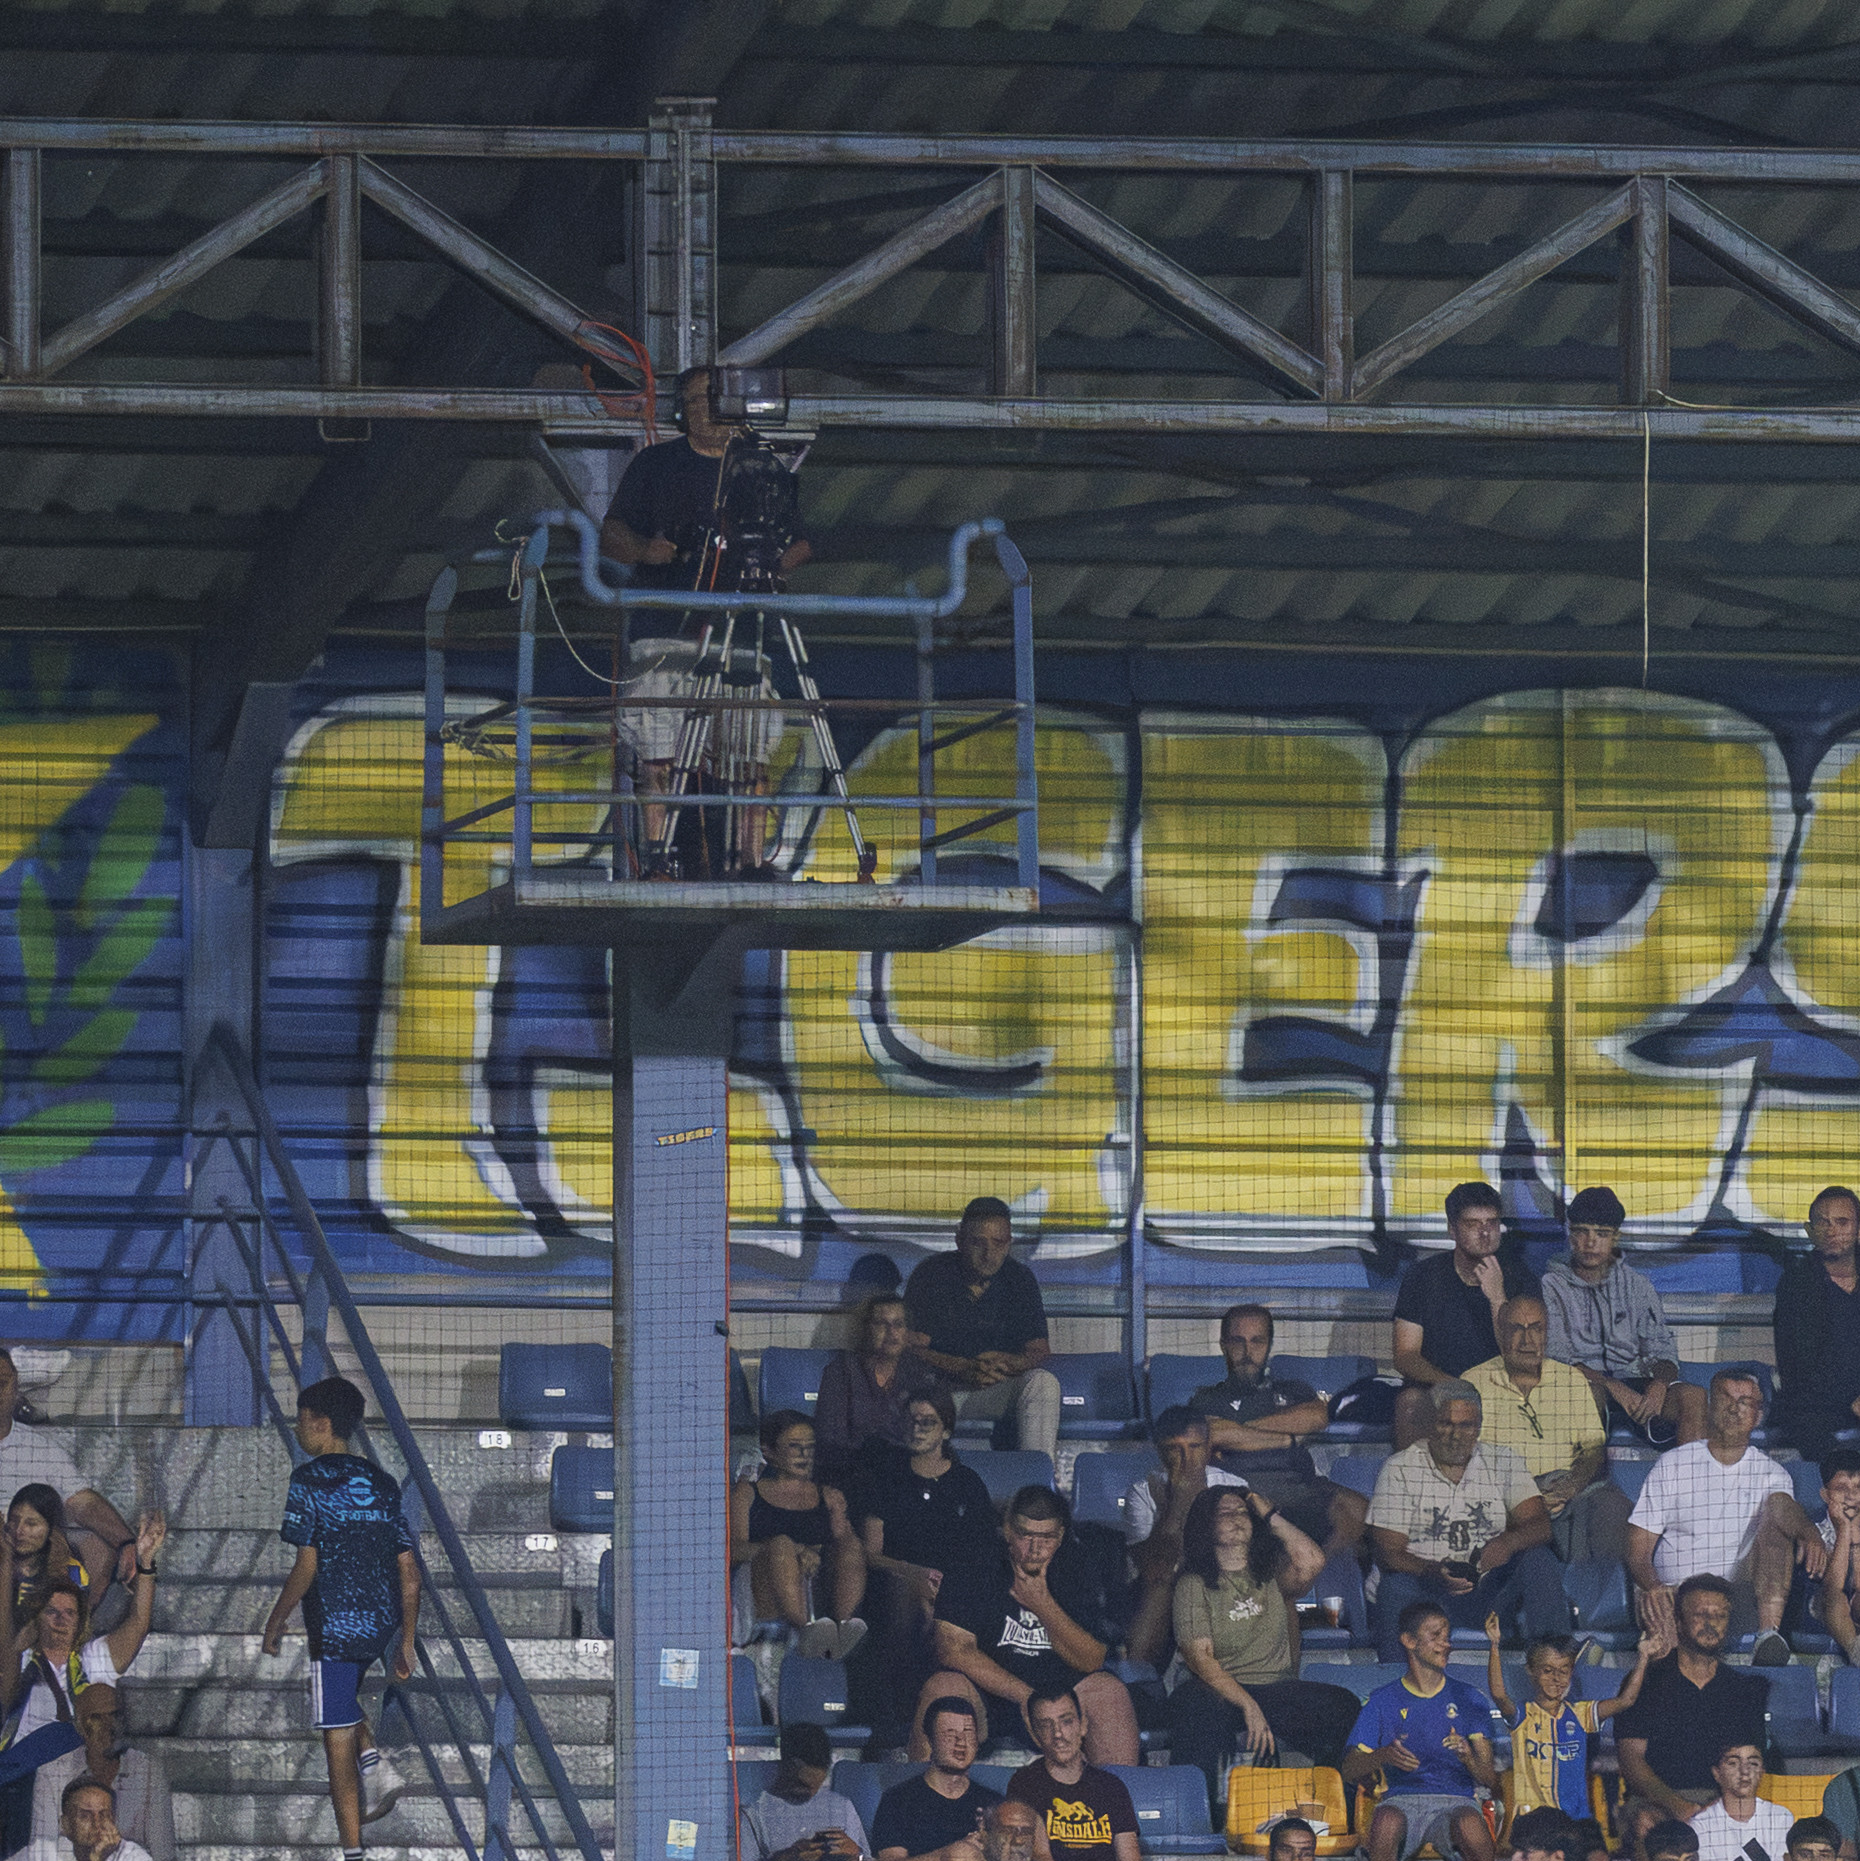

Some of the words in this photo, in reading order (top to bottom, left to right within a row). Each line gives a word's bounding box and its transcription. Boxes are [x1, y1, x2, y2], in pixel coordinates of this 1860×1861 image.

[487, 1434, 503, 1446] 18
[533, 1537, 549, 1549] 17
[584, 1642, 600, 1655] 16
